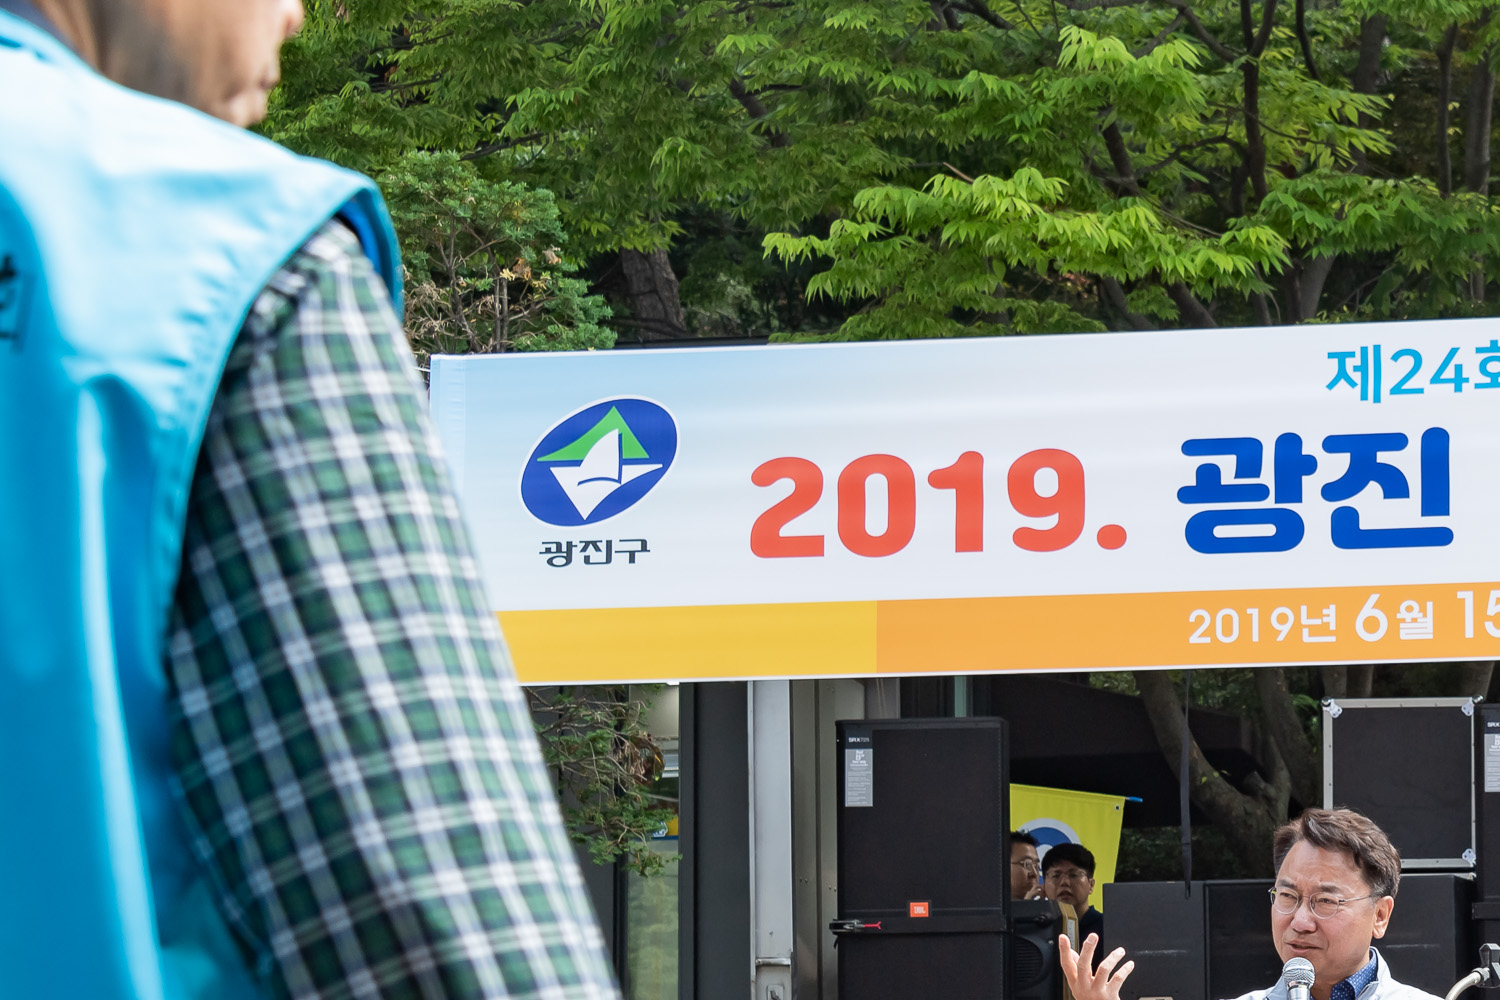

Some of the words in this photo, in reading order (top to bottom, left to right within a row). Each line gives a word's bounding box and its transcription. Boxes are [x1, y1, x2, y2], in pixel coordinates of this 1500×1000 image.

[750, 448, 1127, 558] 2019.
[1176, 426, 1454, 555] 광진
[539, 538, 651, 568] 광진구
[1188, 602, 1337, 644] 2019년
[1354, 593, 1434, 643] 6월
